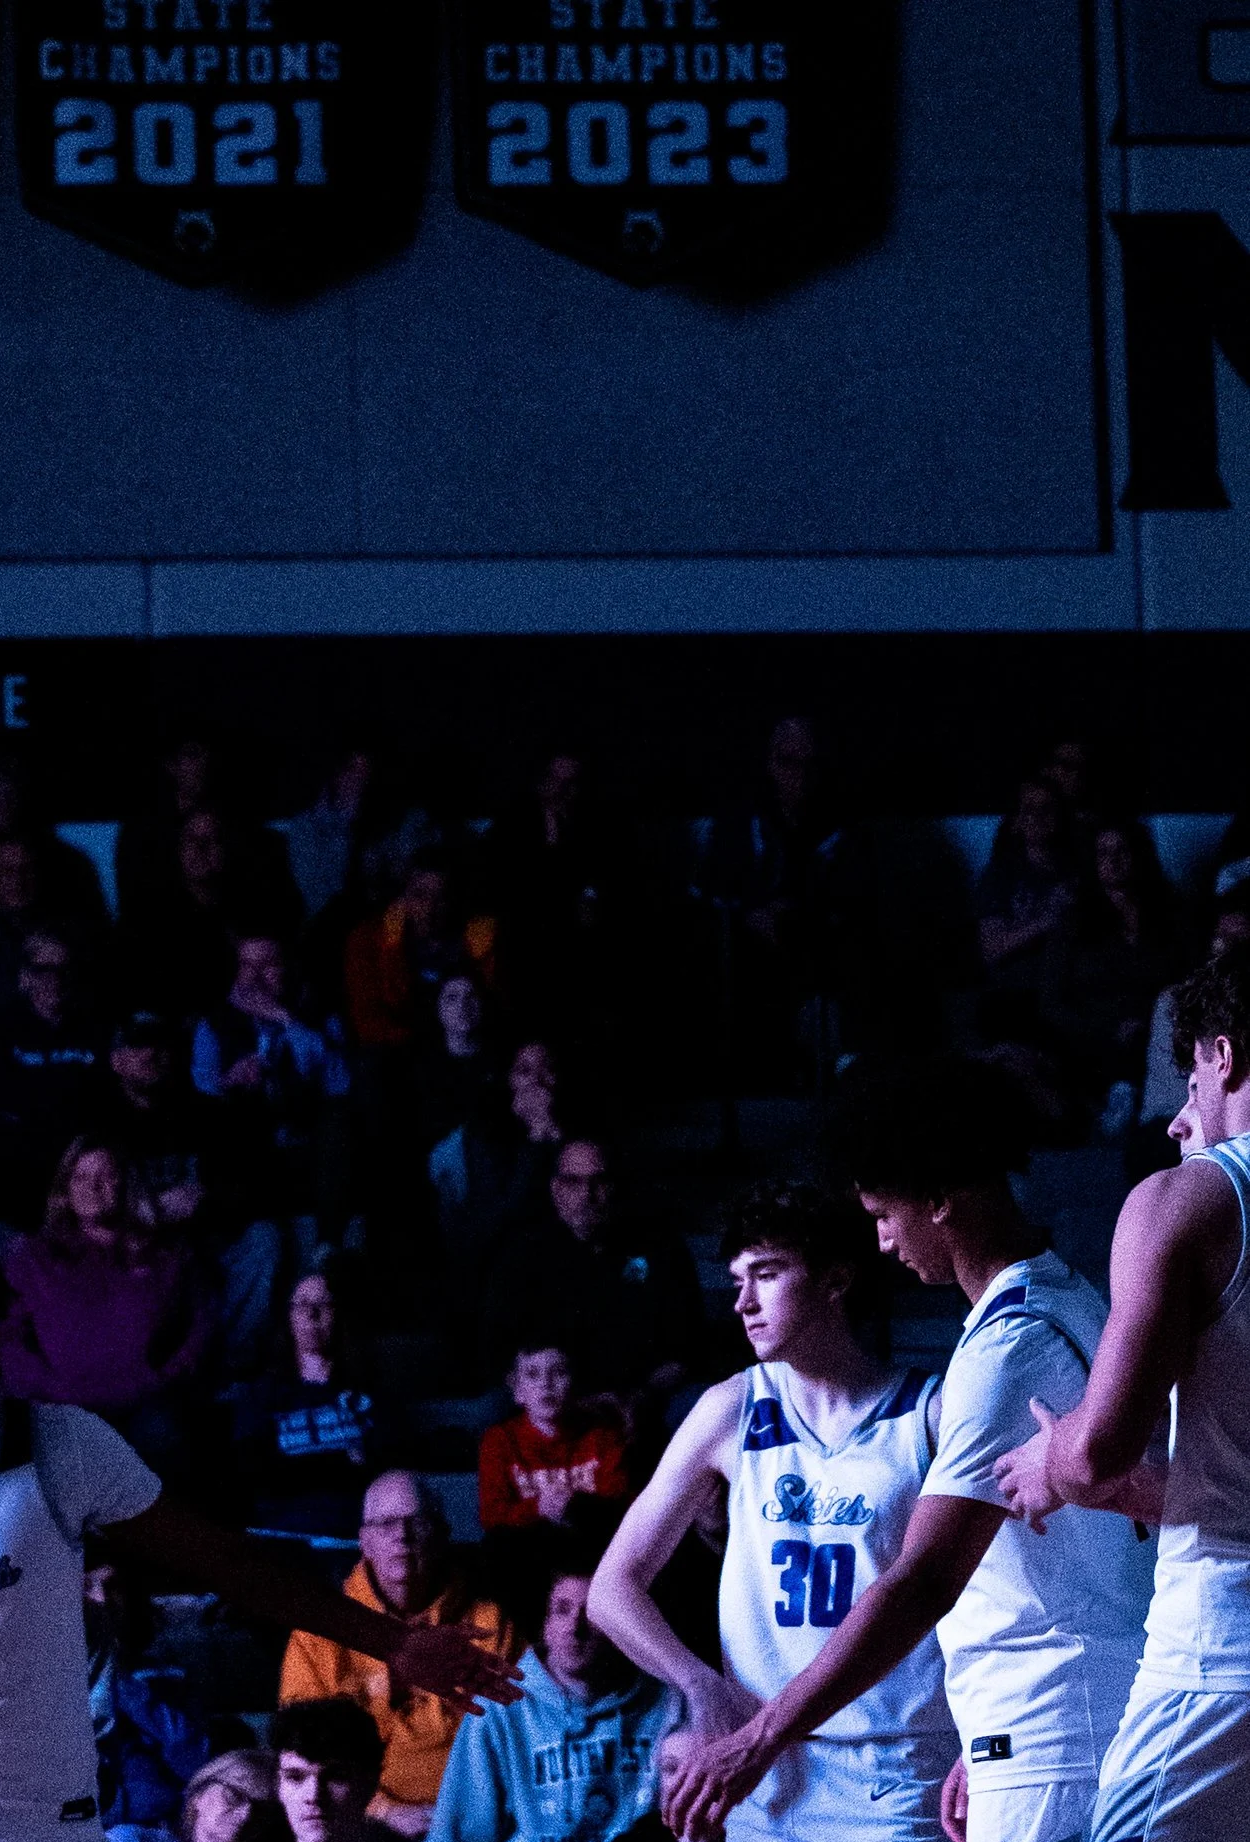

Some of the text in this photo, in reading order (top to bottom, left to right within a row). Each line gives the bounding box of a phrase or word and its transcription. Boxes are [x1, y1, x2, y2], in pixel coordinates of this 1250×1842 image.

[102, 0, 274, 31] STATE
[549, 0, 721, 30] STATE
[38, 38, 341, 84] CHAMPIONS
[484, 42, 788, 84] CHAMPIONS
[52, 97, 328, 187] 2021
[486, 99, 789, 187] 2023
[761, 1473, 875, 1526] Skies
[771, 1539, 856, 1628] 30
[995, 1741, 1003, 1753] L
